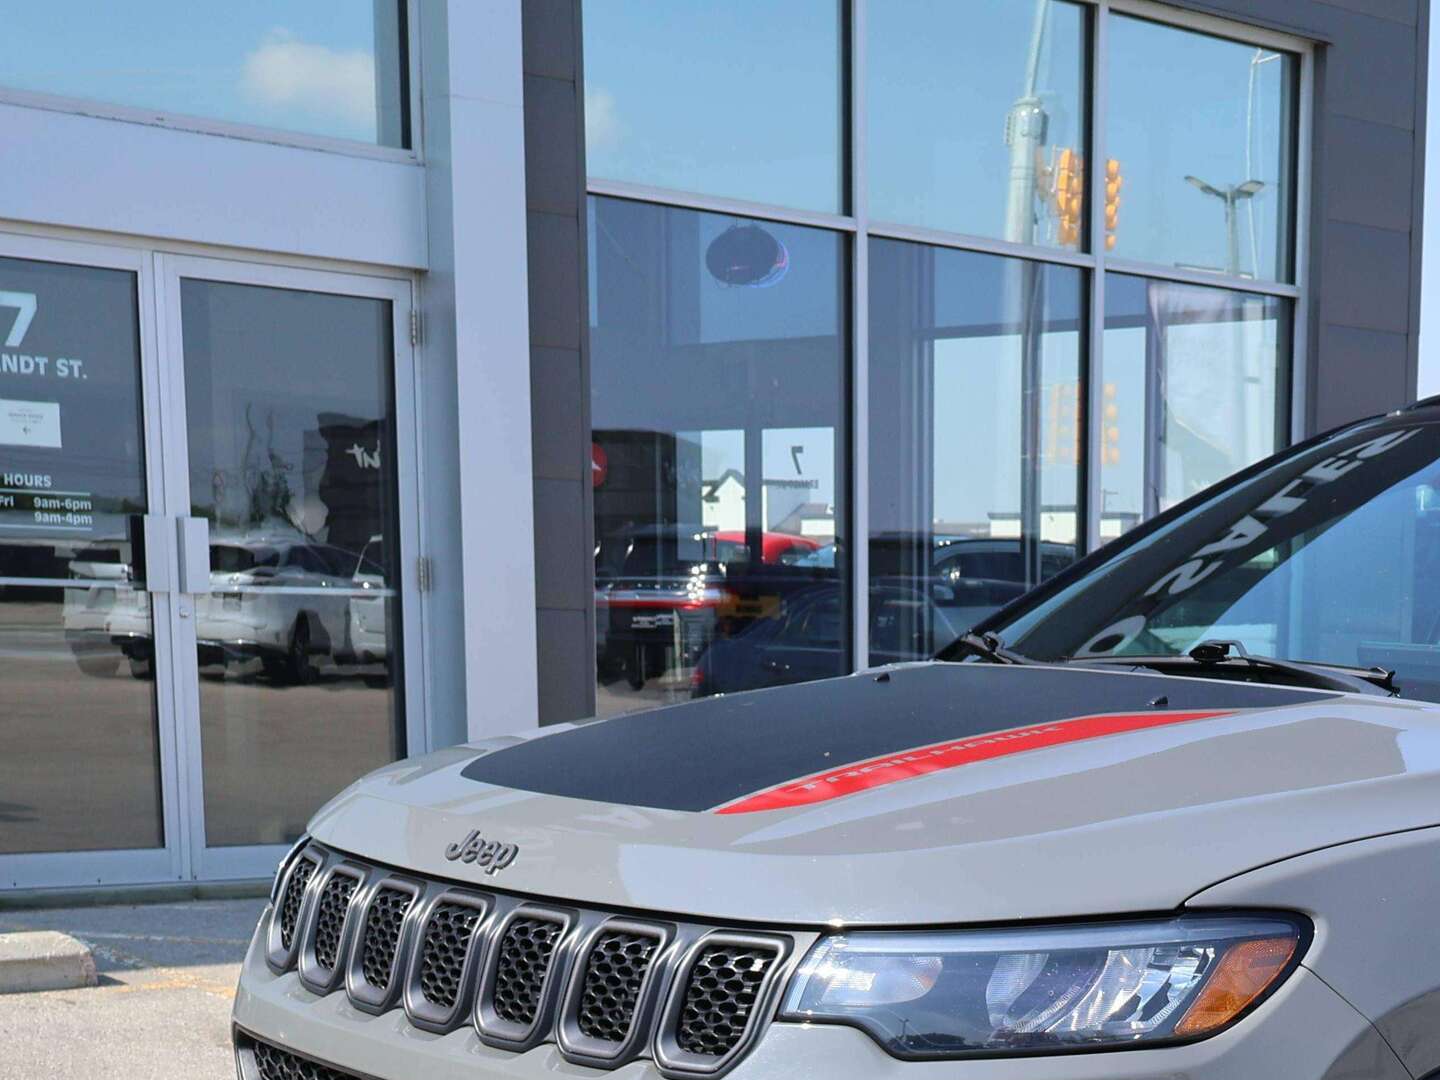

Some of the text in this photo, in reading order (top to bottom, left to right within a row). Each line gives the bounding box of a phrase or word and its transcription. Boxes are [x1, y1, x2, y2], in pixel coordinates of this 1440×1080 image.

[0, 353, 88, 379] NDT ST.
[4, 473, 52, 488] HOURS
[33, 496, 92, 512] 9am-6pm
[34, 510, 93, 525] 9am-4pm
[445, 829, 519, 875] Jeep
